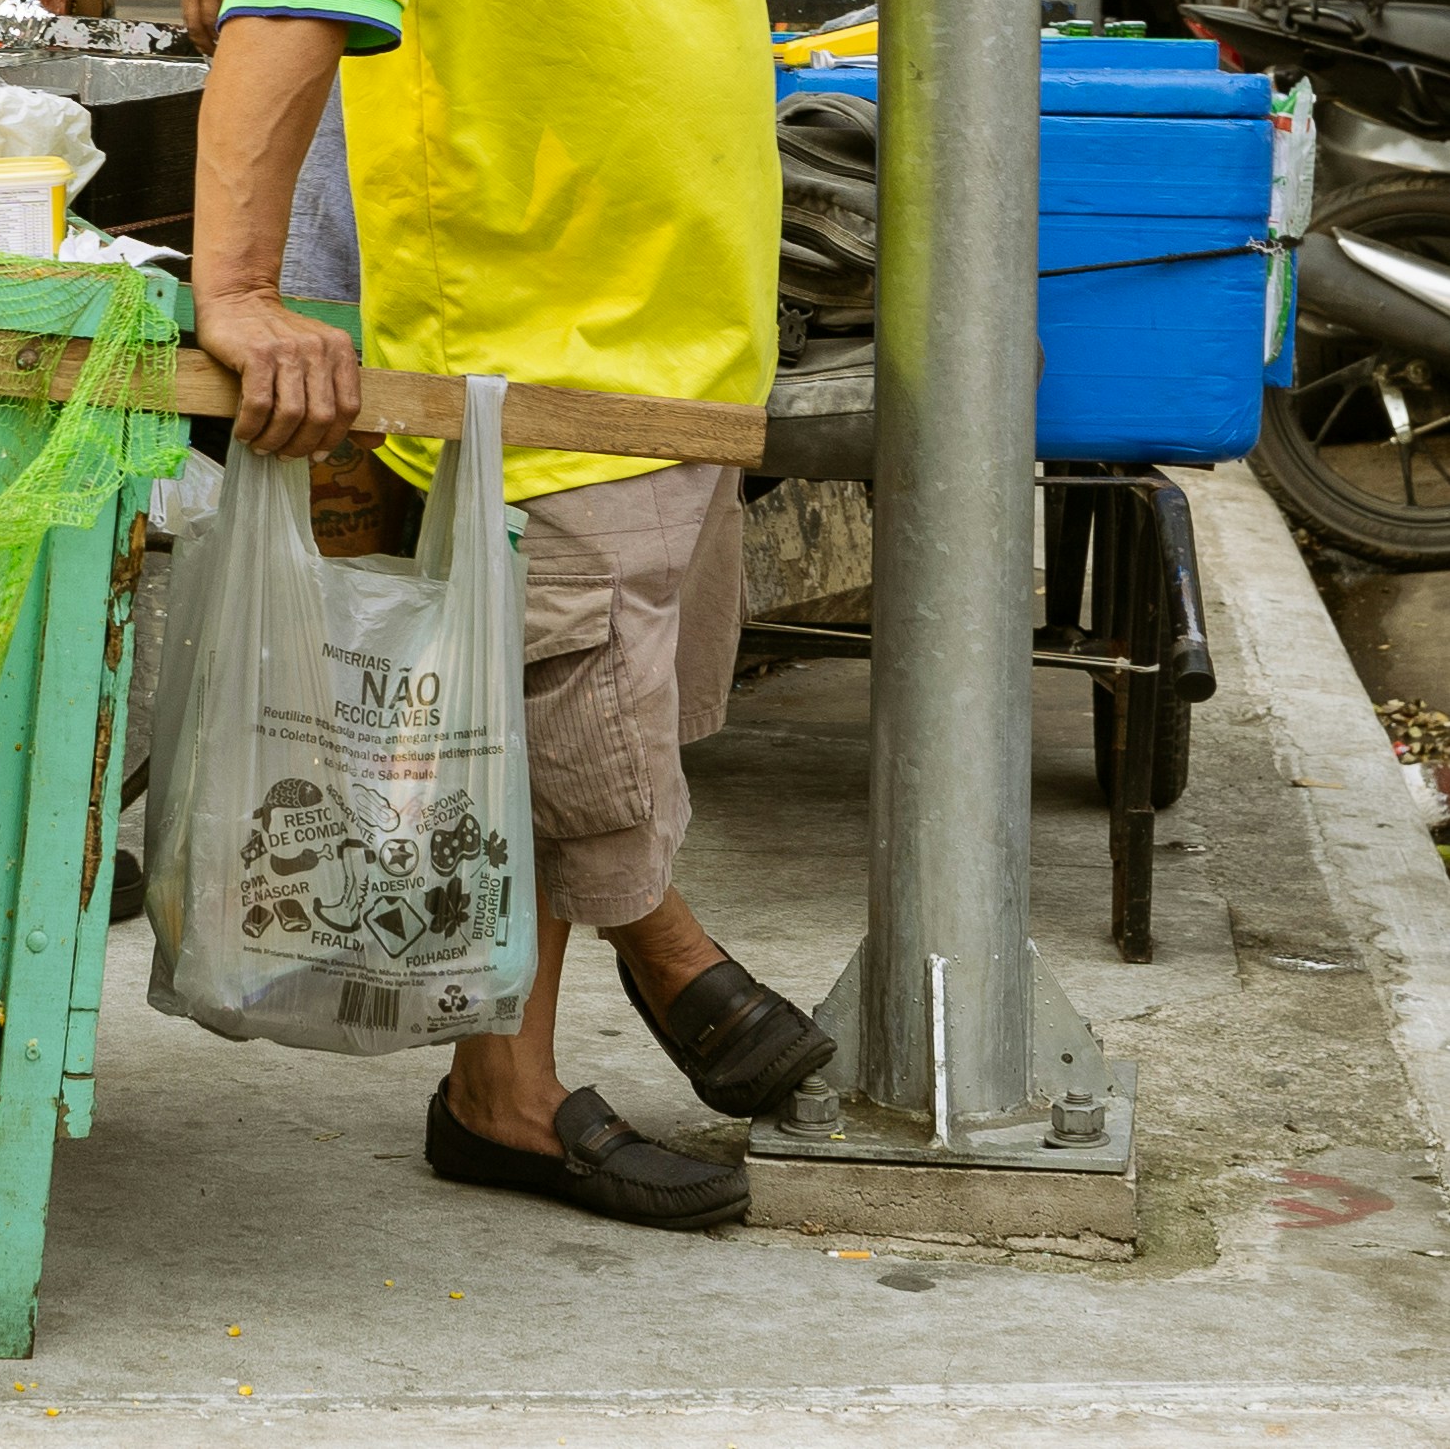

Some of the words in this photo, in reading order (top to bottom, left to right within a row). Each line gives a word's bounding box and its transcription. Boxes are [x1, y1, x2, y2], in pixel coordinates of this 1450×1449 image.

[322, 643, 391, 672] MATERIAIS
[361, 667, 440, 709] NÃO
[263, 706, 312, 724] Reutilize
[358, 733, 381, 745] para
[385, 733, 431, 745] entregar
[269, 728, 276, 737] a
[280, 727, 317, 744] Coleta
[373, 752, 387, 762] de
[361, 769, 374, 778] de
[378, 770, 399, 780] São
[268, 832, 290, 848] DE
[294, 822, 348, 843] COMDA
[416, 820, 433, 835] DE
[371, 877, 425, 893] ADESIVO
[472, 893, 487, 939] BITUCA
[480, 872, 490, 890] DE
[484, 878, 500, 937] CIGARRO
